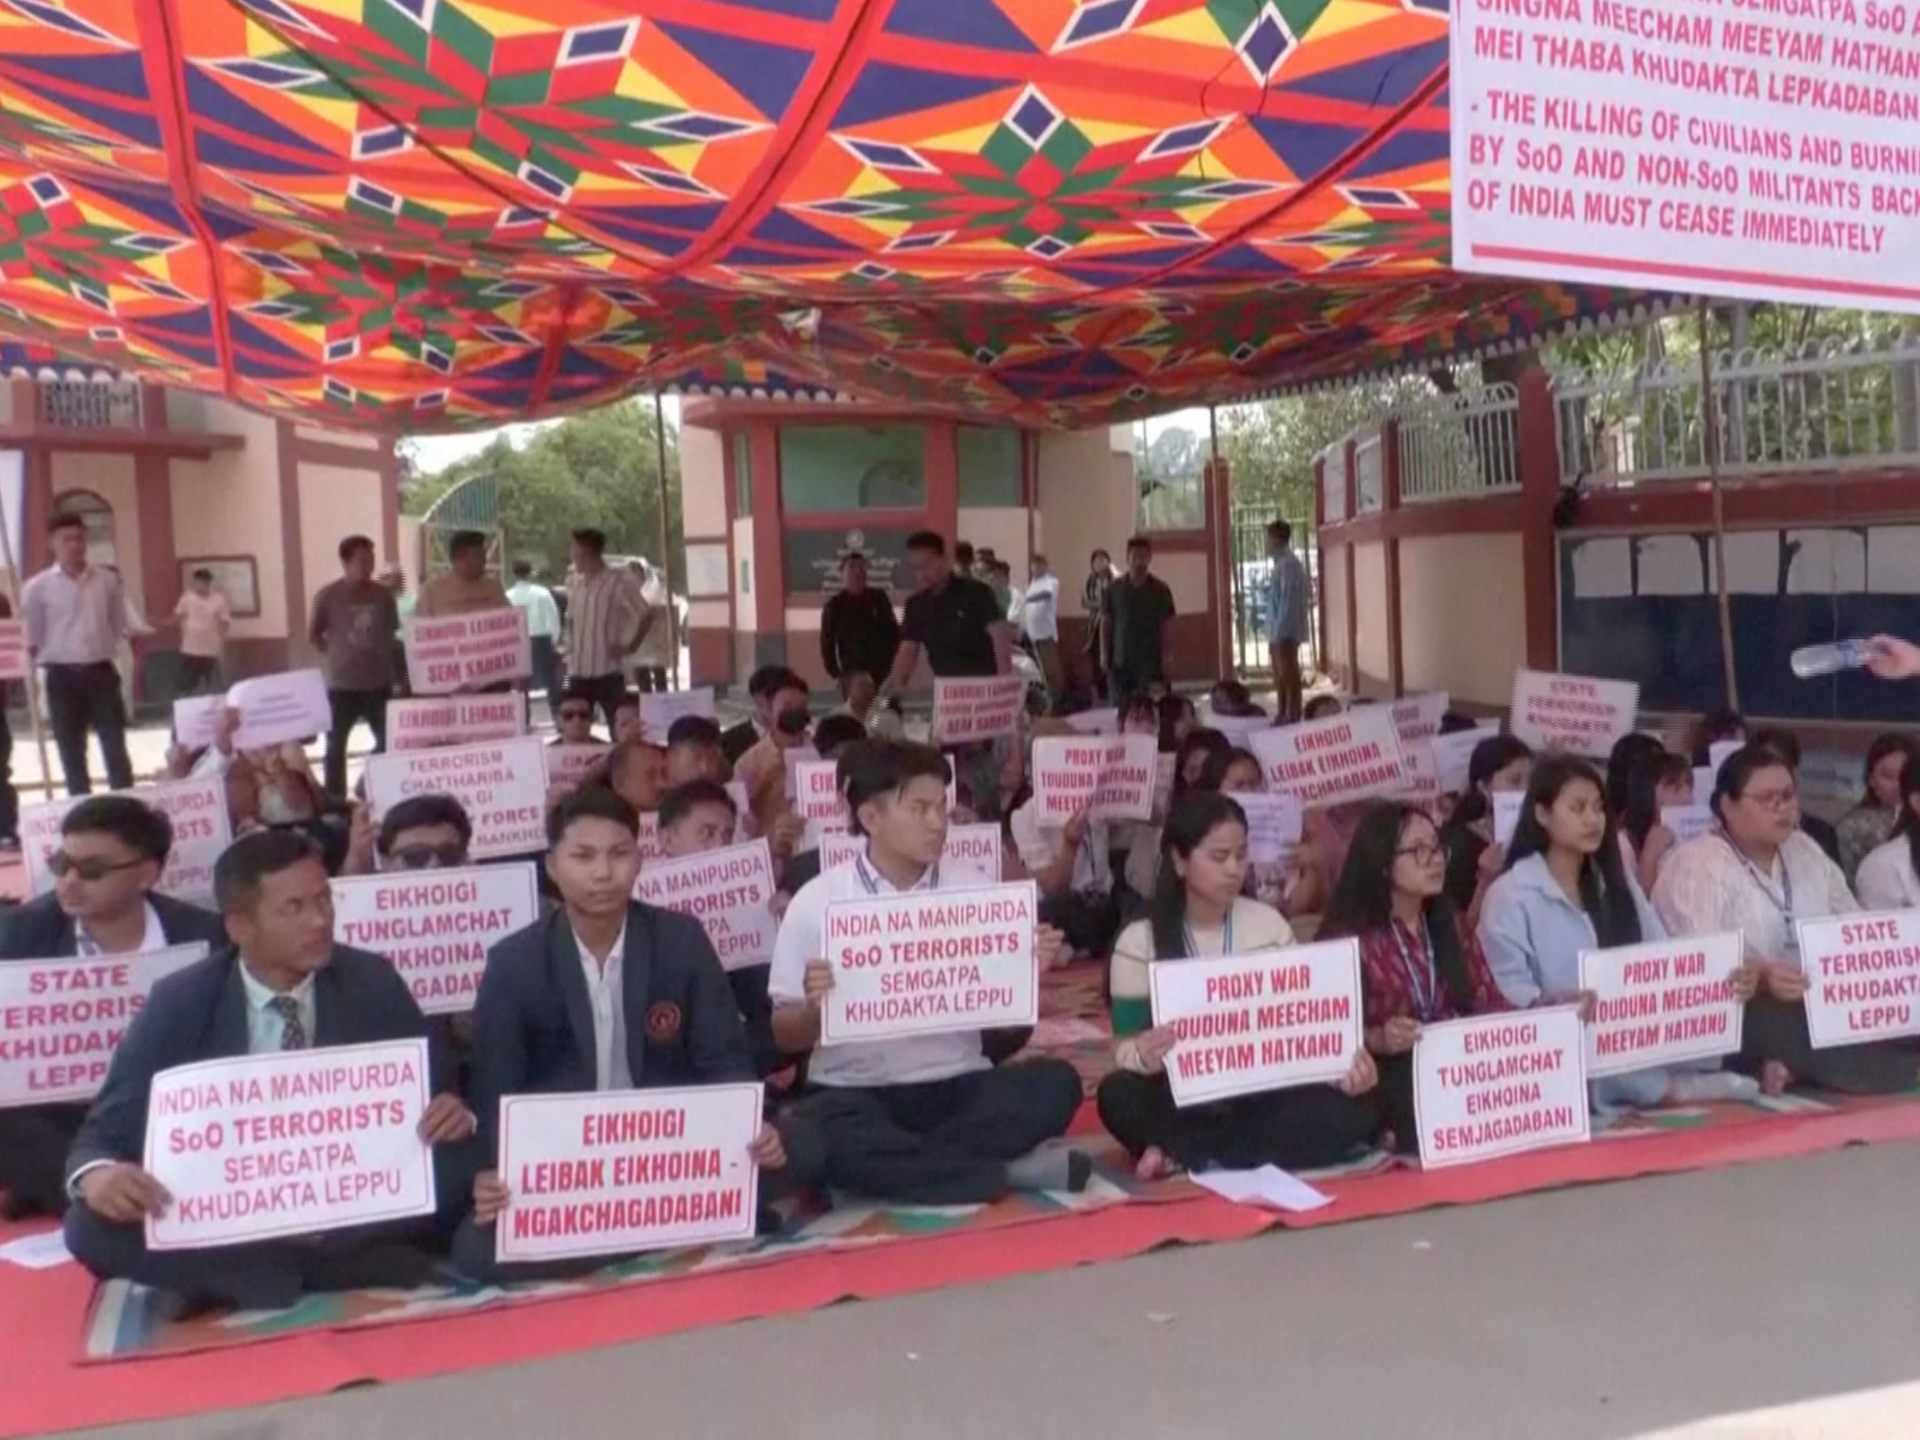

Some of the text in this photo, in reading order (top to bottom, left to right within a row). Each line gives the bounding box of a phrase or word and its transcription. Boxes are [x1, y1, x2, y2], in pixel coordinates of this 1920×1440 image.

[1593, 0, 1712, 48] MEECHAM
[1722, 20, 1823, 64] MEEYAM
[1732, 0, 1857, 25] GATPA
[1865, 0, 1905, 34] SoO
[1474, 25, 1918, 120] MEI THABA KHUDAKTA LEPKADABAN
[1487, 89, 1536, 126] THE
[1544, 97, 1642, 138] KILLING
[1652, 110, 1680, 143] OF
[1687, 116, 1792, 161] CIVILIANS
[1800, 134, 1842, 167] AND
[1850, 142, 1920, 176] BURNI
[1470, 133, 1504, 167] BY
[1517, 139, 1563, 174] SoO
[1574, 146, 1625, 181] AND
[1637, 153, 1739, 194] NON-SoO
[1749, 168, 1861, 210] MILITANTS
[1468, 178, 1884, 253] OF INDIA MUST CEASE IMMEDIATELY
[409, 750, 503, 773] TERRORISM
[1065, 748, 1102, 766] PROXY
[482, 805, 539, 826] FORCE
[667, 854, 764, 893] MANIPURDA
[375, 880, 477, 911] EIKHOIGI
[343, 907, 512, 944] TUNGLAMCHAT
[829, 899, 1029, 938] INDIA NA MANIPURDA
[1841, 919, 1900, 945] STATE
[841, 931, 1019, 969] SoO TERRORISTS
[1623, 951, 1705, 987] PROXY WAR
[29, 963, 130, 994] STATE
[880, 964, 981, 995] SEMGATPA
[1206, 964, 1311, 1003] PROXY WAR
[1823, 974, 1920, 1004] KHUDAKT
[845, 986, 1013, 1023] KHUDAKTA LEPPU
[1174, 996, 1350, 1041] OUDUNA MEECHAM
[1848, 1003, 1910, 1030] LEPPU
[1177, 1032, 1343, 1080] MEEYAM HATKANU
[1464, 1023, 1537, 1054] EIKHOIGI
[1596, 1022, 1660, 1056] MEEYAM
[1437, 1049, 1563, 1088] TUNGLAMCHAT
[158, 1061, 416, 1116] INDIA NA MANIPURDA
[1466, 1082, 1541, 1115] EIKHOINA
[169, 1098, 405, 1154] SoO TERRORISTS
[582, 1108, 685, 1146] EIKHOIGI
[1433, 1106, 1573, 1150] SEMJAGADABANI
[223, 1142, 357, 1184] SEMGATPA
[521, 1158, 604, 1195] LEIBAK
[613, 1148, 721, 1187] EIKHOINA
[178, 1168, 401, 1224] KHUDAKTA LEPPU
[513, 1187, 742, 1239] NGAKCHAGADABANI
